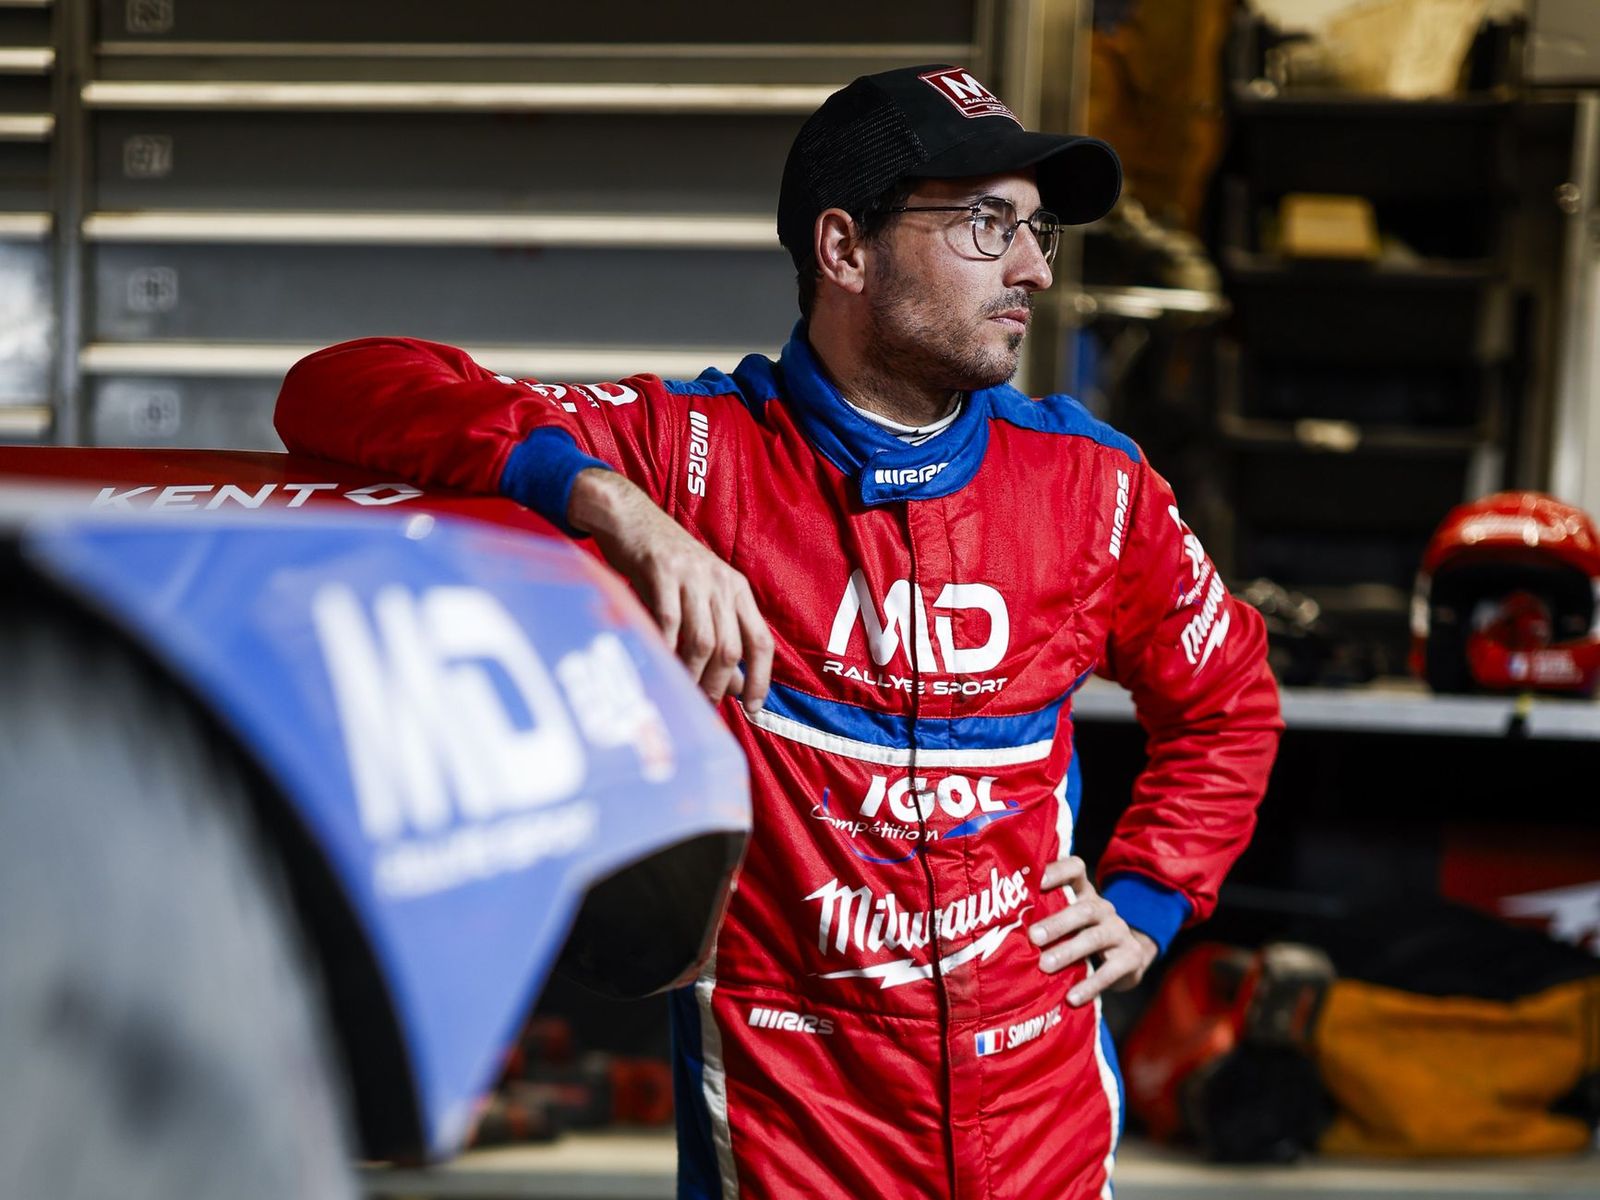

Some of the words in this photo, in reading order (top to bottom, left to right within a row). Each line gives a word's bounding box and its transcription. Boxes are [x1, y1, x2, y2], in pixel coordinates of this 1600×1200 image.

[90, 483, 338, 511] KENT
[827, 568, 1010, 673] MD
[933, 677, 1008, 695] SPORT
[859, 775, 1008, 822] IGOL
[803, 867, 1028, 955] Milwaukee
